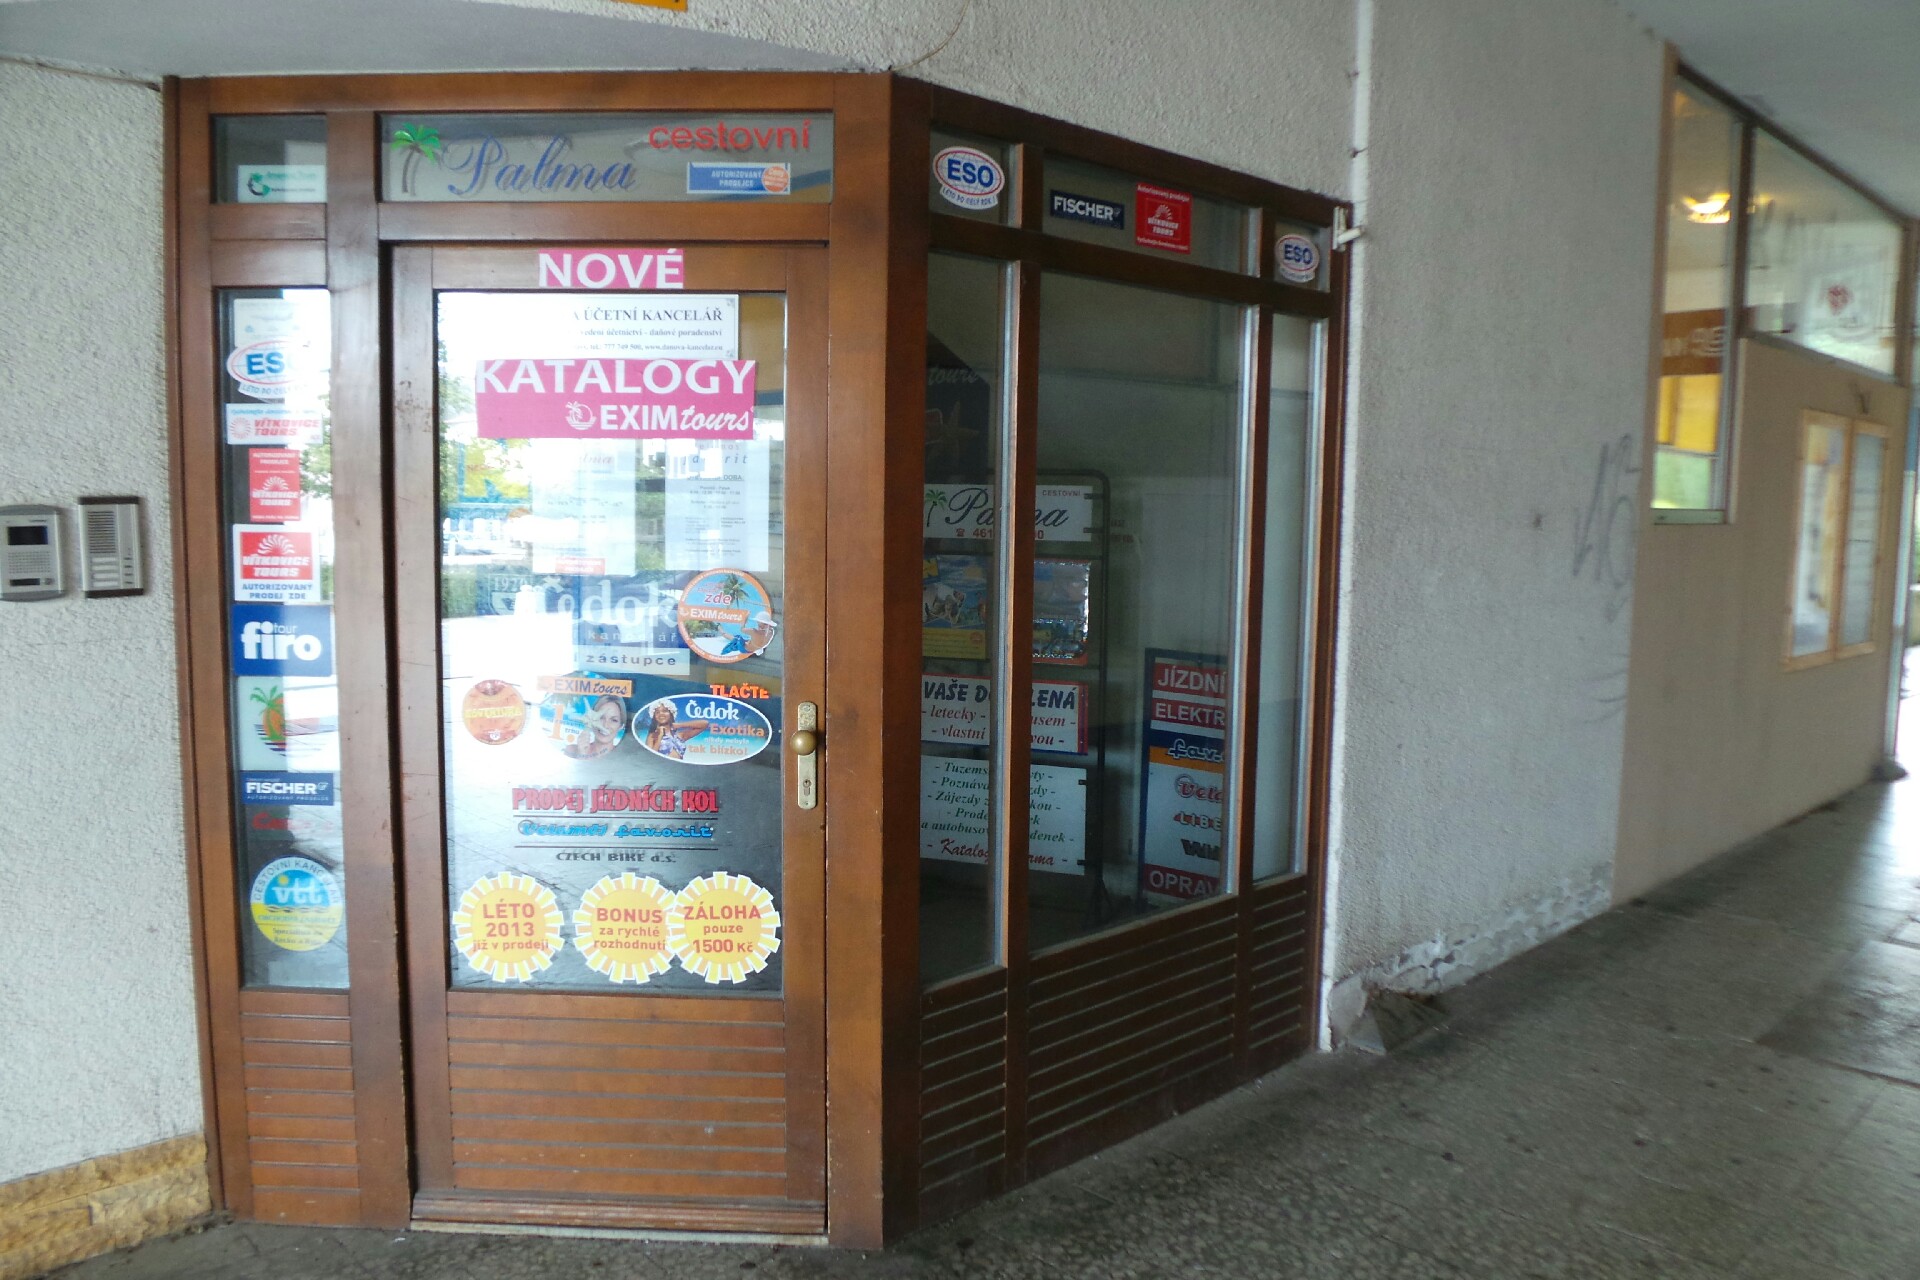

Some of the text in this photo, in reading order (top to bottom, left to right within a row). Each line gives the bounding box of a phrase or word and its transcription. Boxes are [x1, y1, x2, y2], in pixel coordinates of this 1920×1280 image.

[648, 120, 812, 151] cestovní
[444, 131, 638, 196] Palma
[947, 158, 993, 188] ESO
[1053, 194, 1115, 223] FISCHER
[1284, 244, 1313, 265] ESO
[538, 249, 683, 290] NOVÉ
[583, 306, 638, 321] ÚČETNÍ
[642, 306, 724, 322] KANCELÁŘ
[476, 359, 757, 395] KATALOGY
[254, 417, 320, 428] VÍTKOVICE
[254, 427, 298, 437] TOURS
[1041, 488, 1082, 498] CESTOVNÍ
[241, 554, 311, 566] VÍTKOVICE
[252, 567, 300, 578] TOURS
[248, 591, 308, 601] PRODEJ ZDE
[703, 591, 733, 606] zde
[274, 622, 298, 634] tour
[240, 620, 323, 662] firo
[585, 653, 677, 667] zástupce
[1157, 664, 1226, 696] JÍZDNÍ
[709, 683, 770, 700] TLAČTE
[923, 678, 969, 703] VAŠE
[684, 697, 741, 721] Čedok
[929, 704, 977, 723] letecky
[1154, 702, 1226, 728] ELEKTR
[708, 723, 766, 739] Exotika
[940, 725, 986, 741] vlastní
[688, 744, 748, 757] tak blízko!
[1166, 738, 1225, 764] fav
[944, 761, 988, 777] Tuzems
[245, 781, 318, 796] FISCHER
[511, 782, 720, 815] PRODEJ JÍZDNÍCH KOL
[934, 790, 980, 808] Zájezdy
[920, 823, 929, 831] a
[1178, 811, 1222, 832] LIBE
[614, 822, 714, 840] favorit
[555, 852, 679, 864] CZECH BIKE a.s.
[1148, 869, 1220, 900] OPRAV
[482, 897, 536, 920] LÉTO
[596, 907, 664, 924] BONUS
[683, 901, 762, 922] ZÁLOHA
[485, 922, 535, 938] 2013
[599, 925, 661, 941] za rychlé
[703, 924, 744, 940] pouze
[472, 938, 549, 952] již v prodeji
[593, 938, 667, 952] rozhodnutí
[692, 938, 755, 954] 1500 Kč
